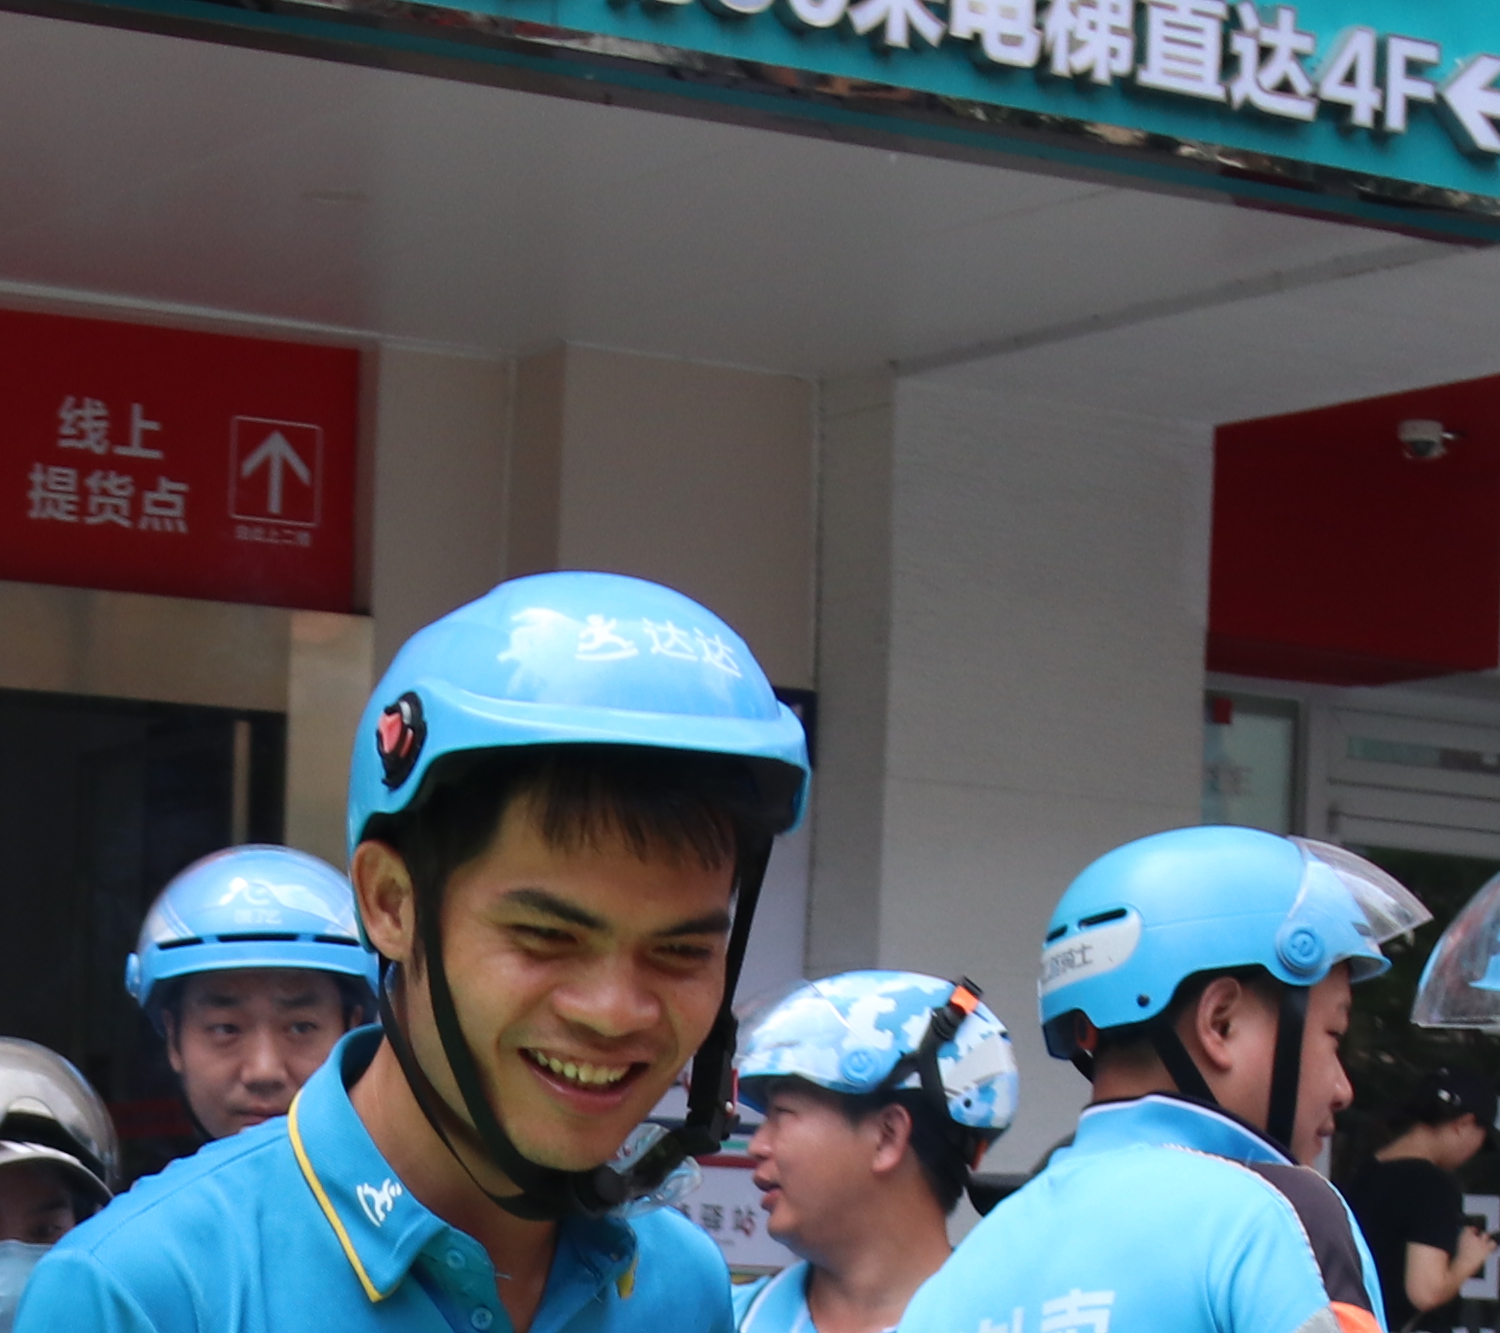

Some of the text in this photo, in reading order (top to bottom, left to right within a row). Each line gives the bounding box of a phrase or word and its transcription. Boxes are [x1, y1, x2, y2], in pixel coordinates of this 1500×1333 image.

[57, 397, 164, 462] 线上
[28, 463, 190, 534] 提货点
[639, 617, 741, 677] 达达
